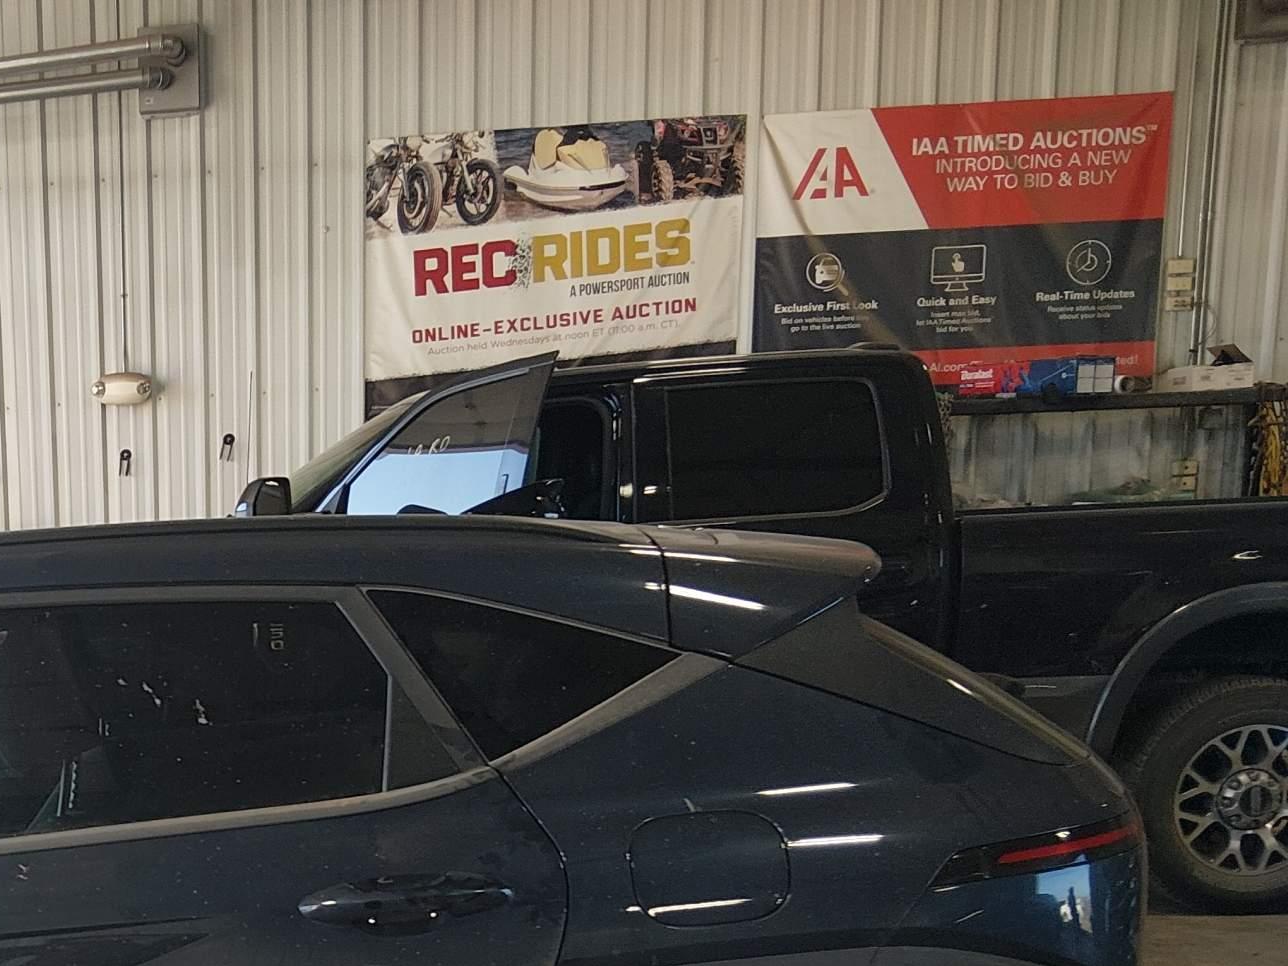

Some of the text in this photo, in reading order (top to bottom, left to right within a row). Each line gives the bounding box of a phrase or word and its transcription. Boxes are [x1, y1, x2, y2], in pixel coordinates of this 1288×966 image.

[912, 136, 949, 156] IAA
[954, 132, 1024, 154] TIMED
[935, 148, 1132, 174] INTRODUCING A NEW
[946, 168, 1118, 193] WAY TO BID & BUY
[413, 217, 691, 297] REC RIDES
[570, 271, 690, 298] A POWERSPORT AUCTION
[1035, 289, 1136, 302] Real-Time Updates
[774, 299, 879, 314] Exclusive First Look
[916, 294, 998, 307] Quick and Easy
[411, 297, 697, 344] ONLINE-EXCLUSIVE AUCTION
[428, 344, 465, 356] Auction
[467, 341, 488, 352] held
[490, 334, 551, 349] Wednesdays
[552, 332, 562, 341] at
[565, 330, 590, 340] noon
[592, 328, 604, 337] ET
